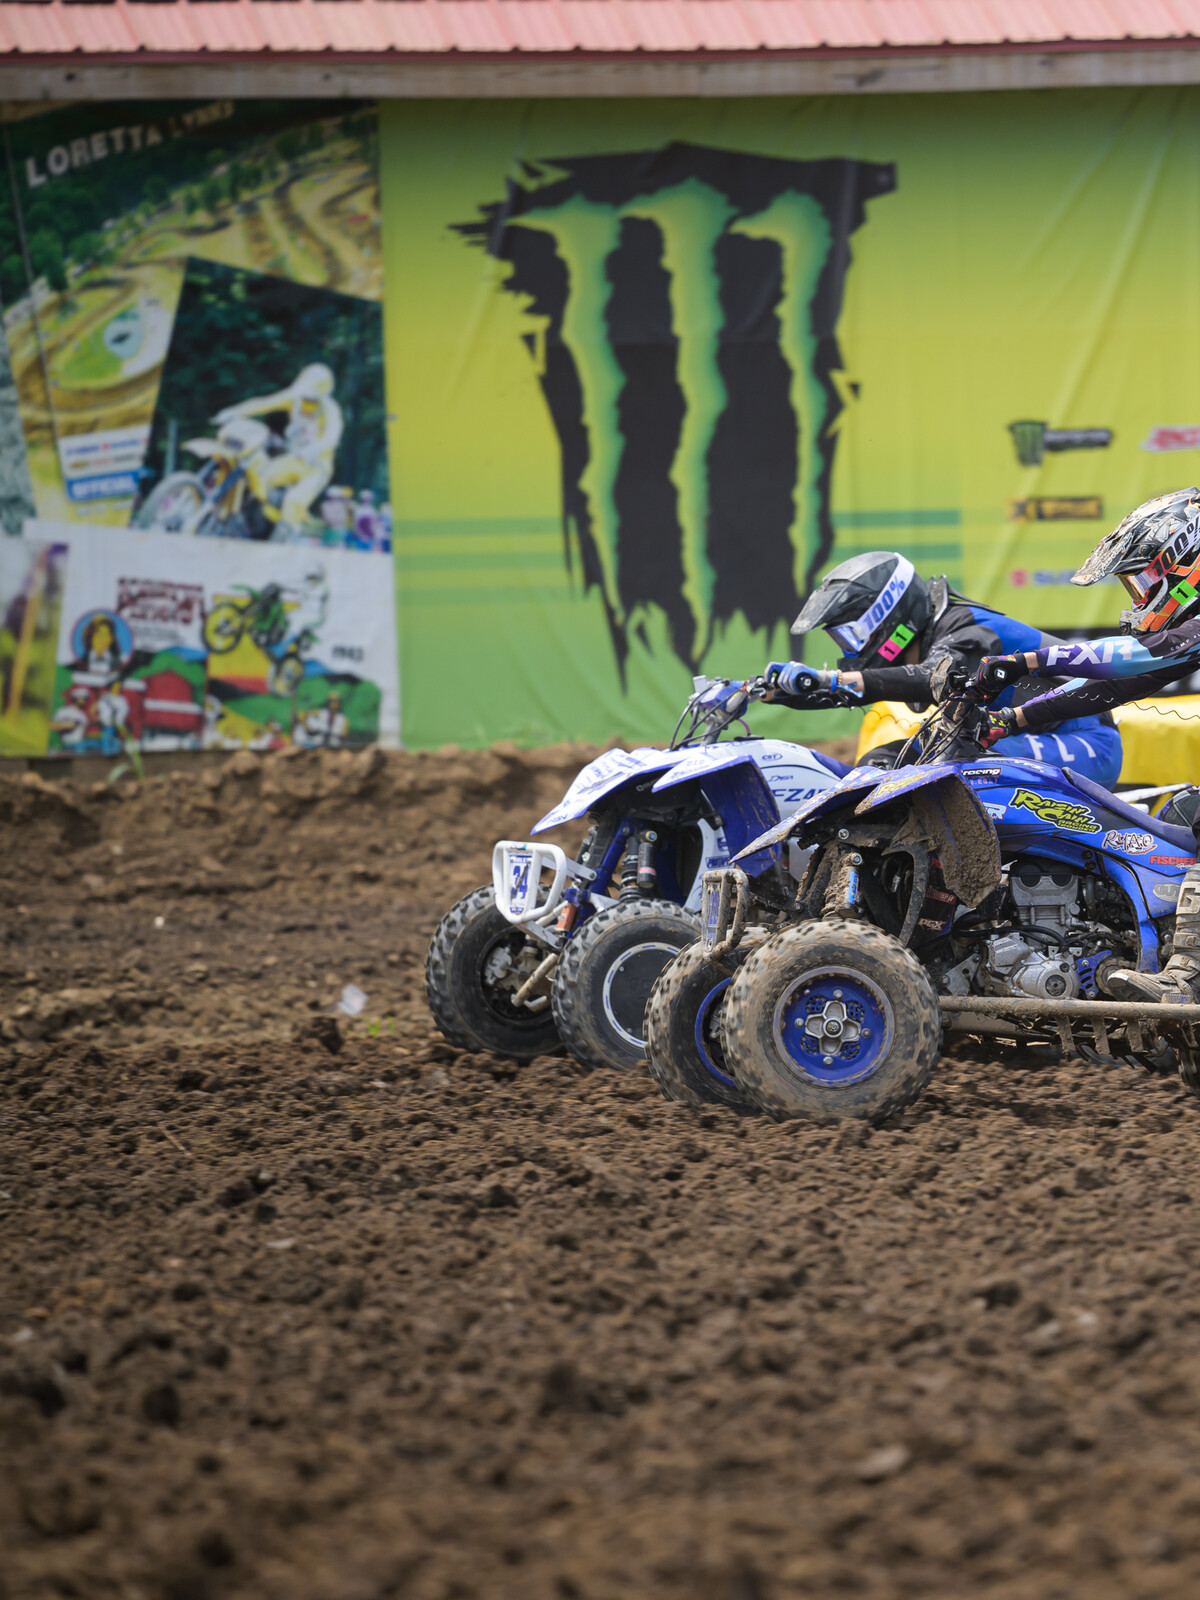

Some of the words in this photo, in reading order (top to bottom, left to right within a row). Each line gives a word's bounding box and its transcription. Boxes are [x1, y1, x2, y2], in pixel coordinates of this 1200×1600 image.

[25, 123, 163, 188] LORETTA
[863, 576, 906, 632] 100%
[1046, 639, 1134, 667] FXR
[962, 768, 1001, 777] racing
[1037, 807, 1089, 824] CAIN
[1150, 855, 1197, 866] FISCHER
